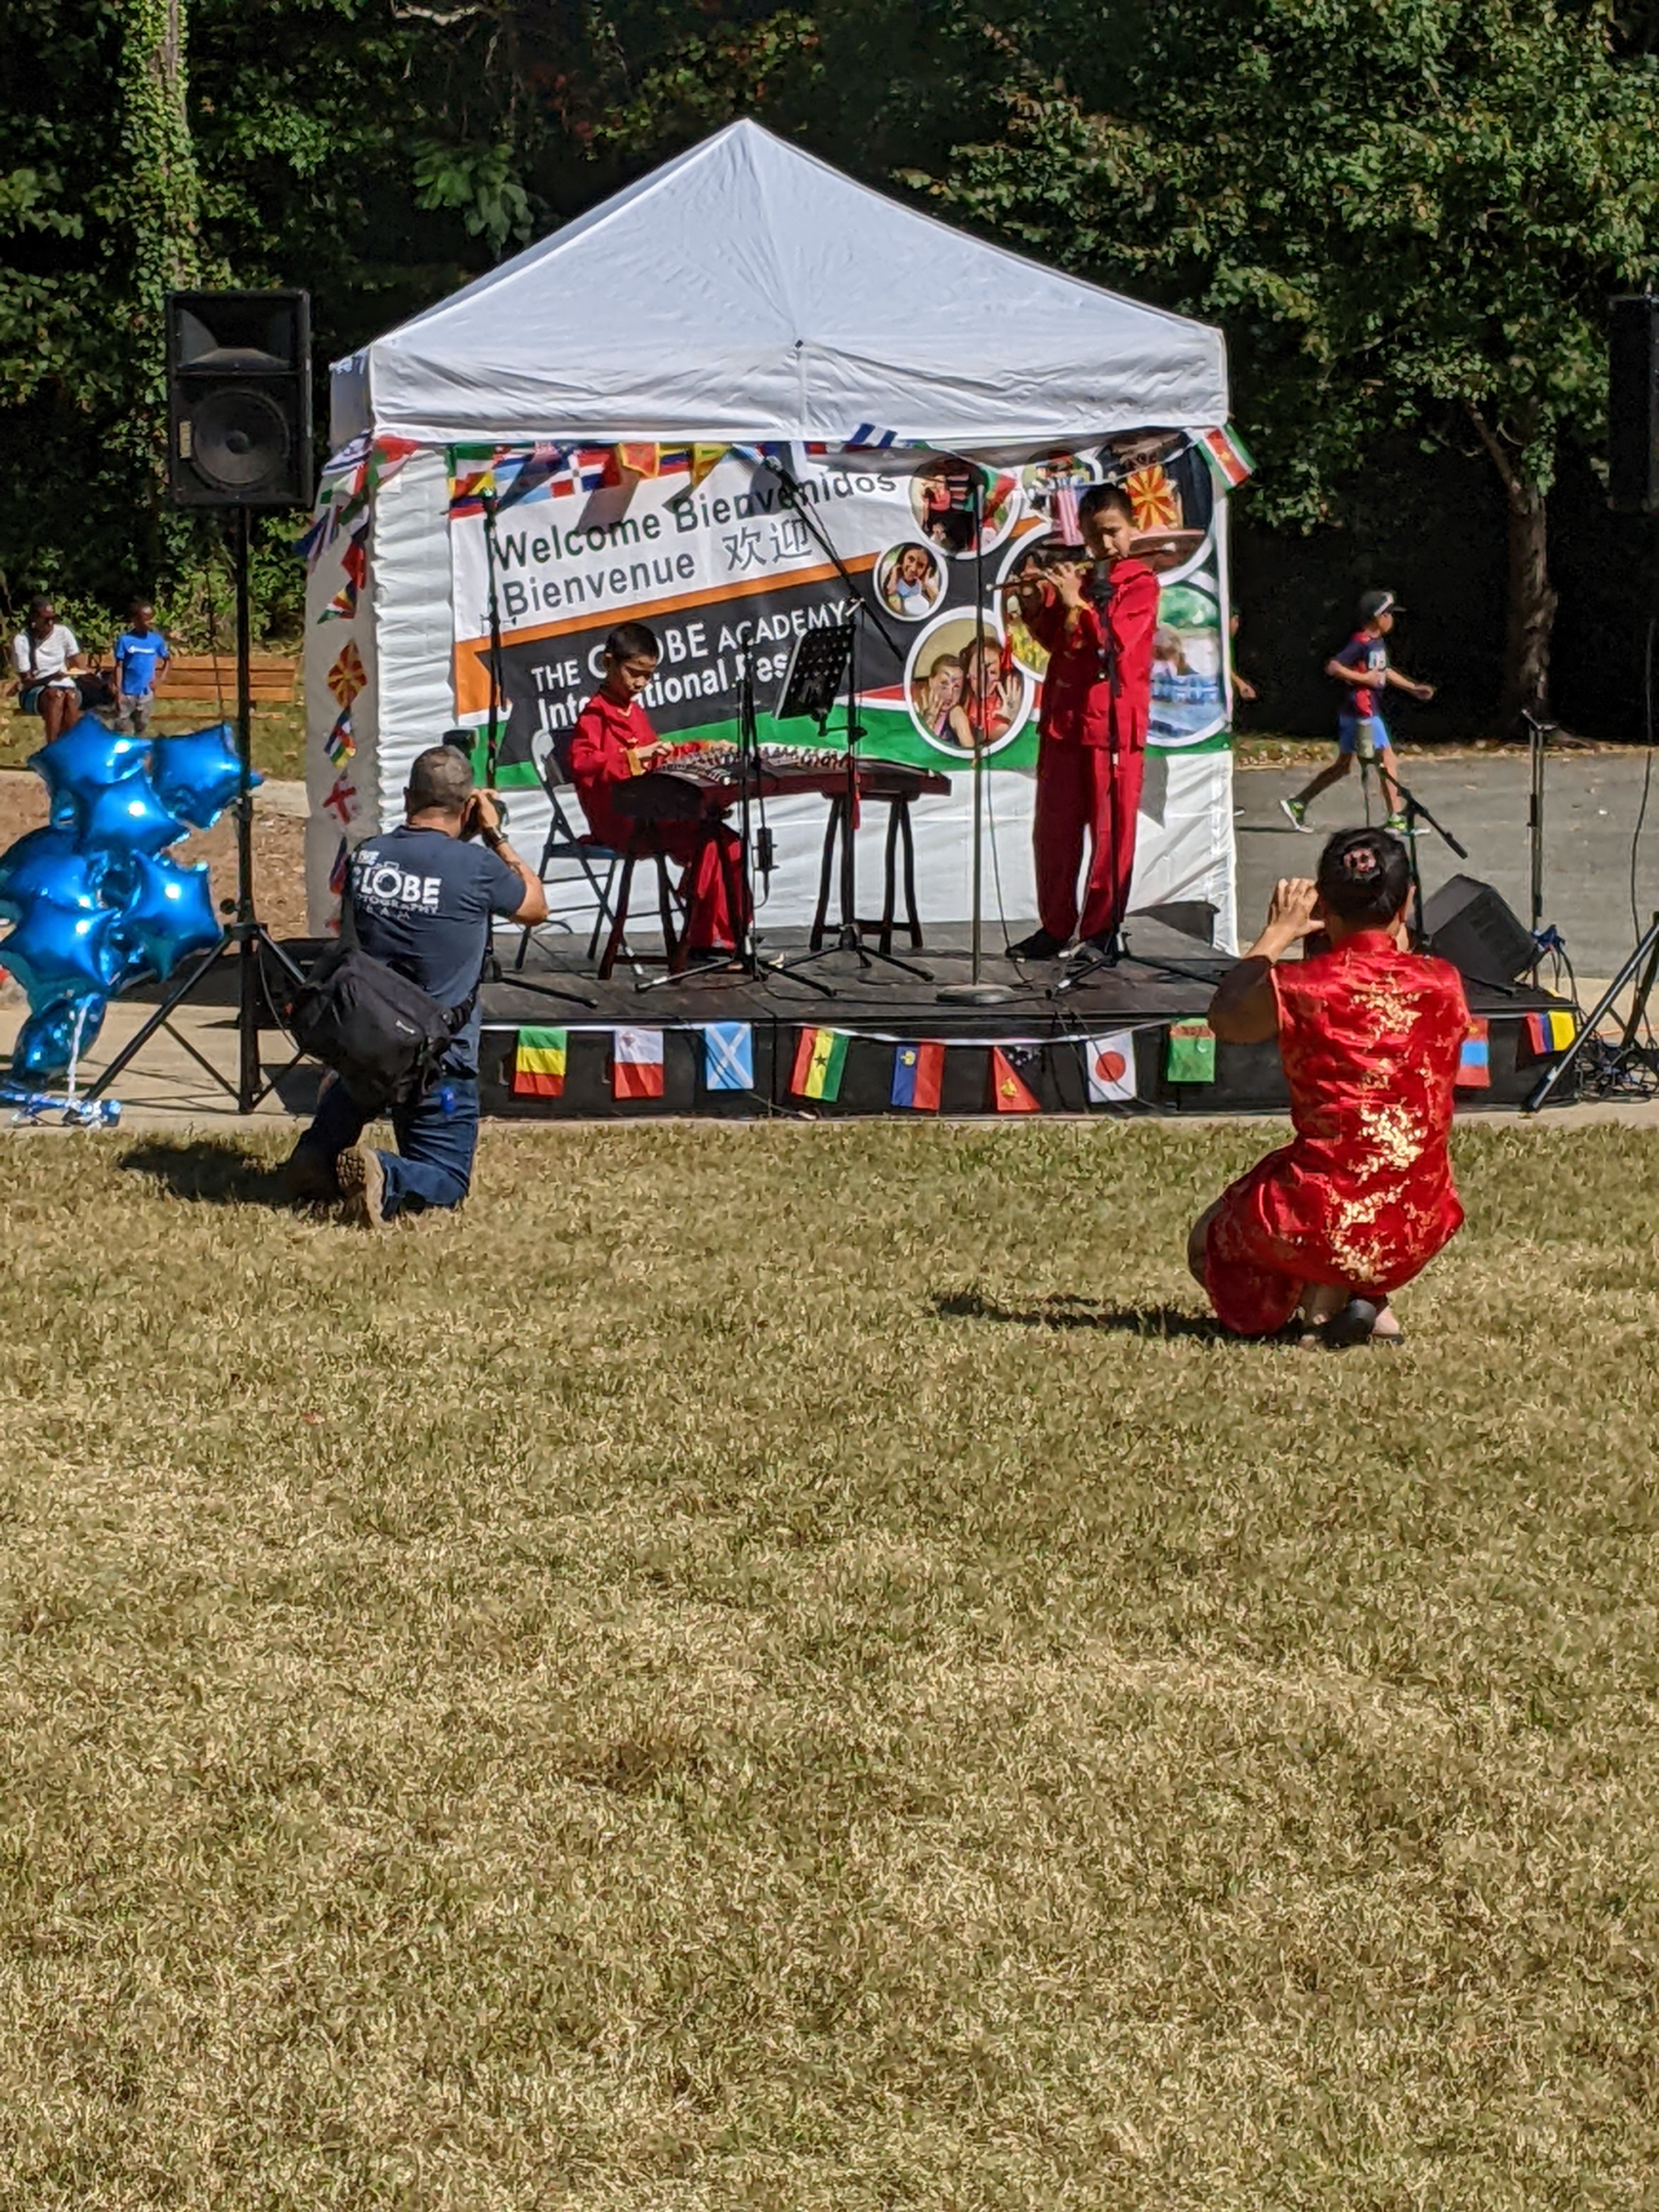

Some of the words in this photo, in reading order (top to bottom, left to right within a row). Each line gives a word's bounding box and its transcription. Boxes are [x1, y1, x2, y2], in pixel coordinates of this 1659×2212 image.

[493, 514, 661, 571] Welcome
[673, 471, 898, 533] Bienvenidos
[722, 517, 812, 572] 欢迎
[503, 553, 696, 617] Bienvenue
[531, 659, 582, 692] THE
[587, 621, 709, 679] GBE
[718, 598, 845, 653] ACADEMY
